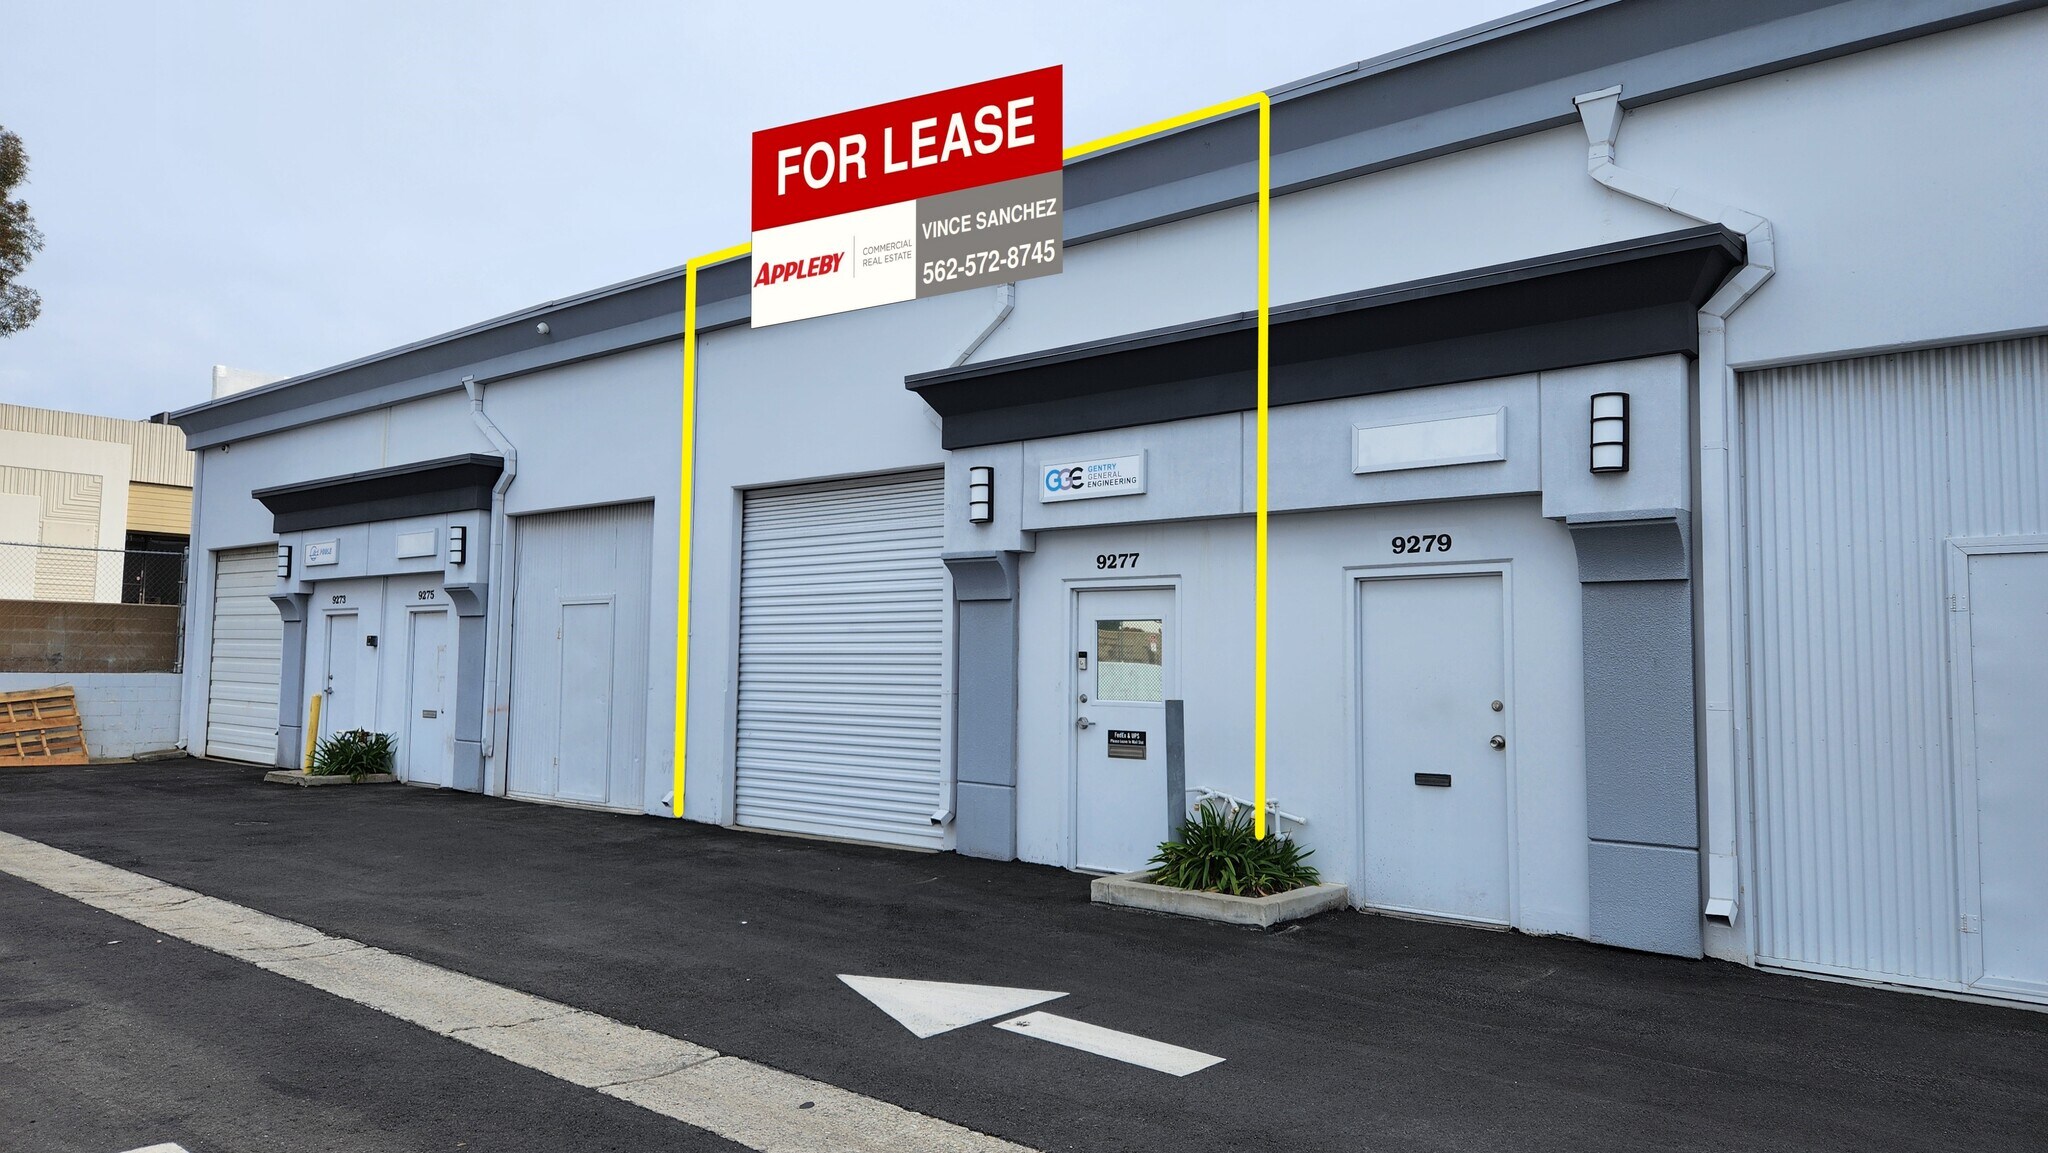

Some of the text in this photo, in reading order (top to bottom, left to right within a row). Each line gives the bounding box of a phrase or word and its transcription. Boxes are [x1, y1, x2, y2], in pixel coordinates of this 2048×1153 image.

[1087, 463, 1117, 473] GENTRY
[1087, 471, 1122, 480] GENERAL
[1087, 476, 1137, 488] ENGINEERING
[1391, 533, 1452, 555] 9279
[1096, 552, 1140, 570] 9277
[332, 594, 347, 605] 9273
[418, 589, 435, 600] 9275
